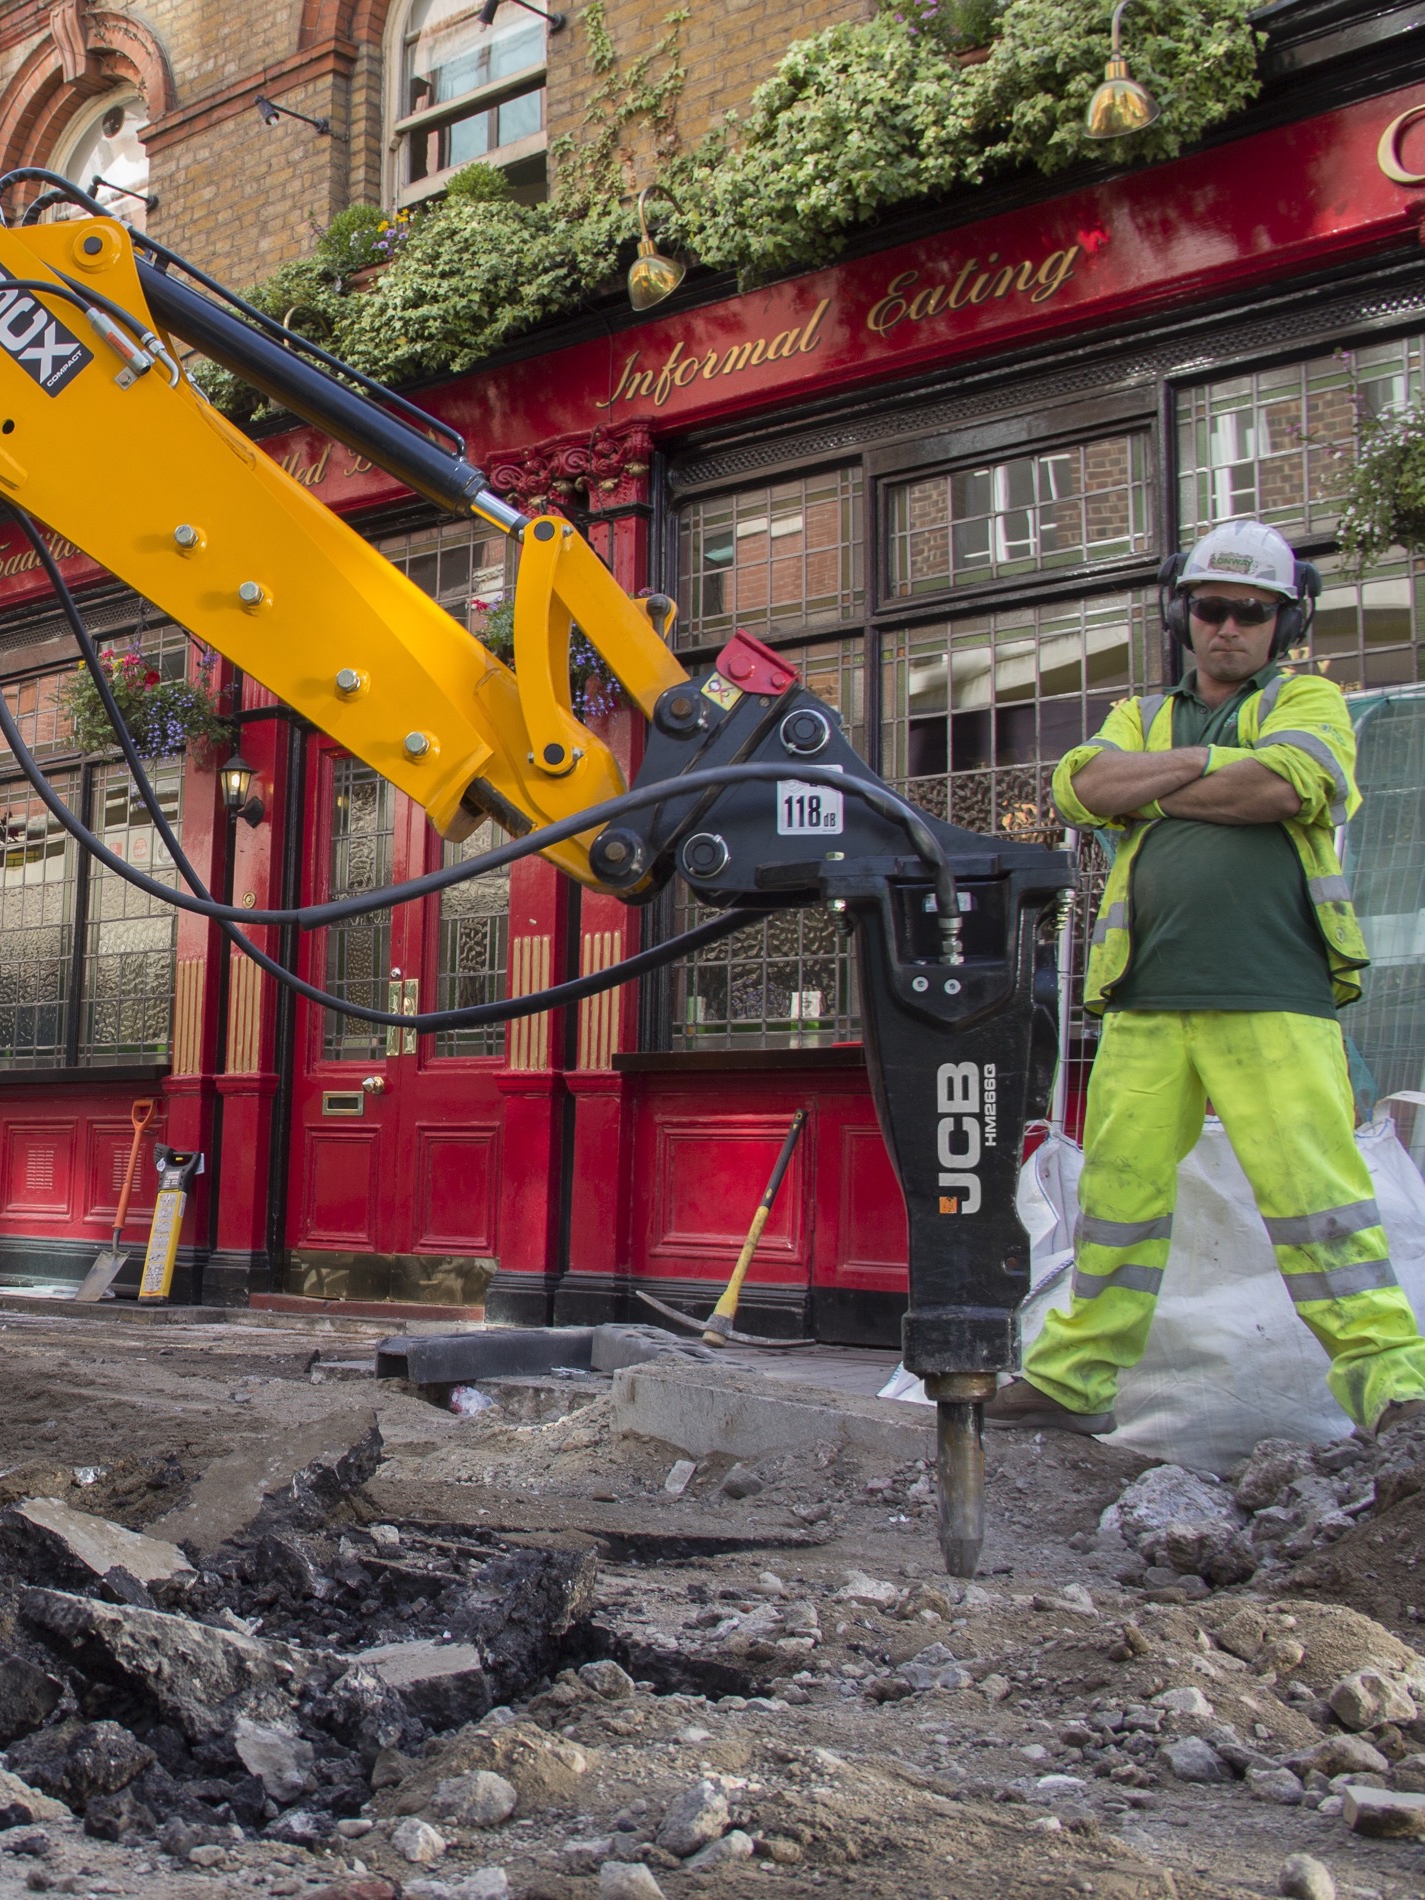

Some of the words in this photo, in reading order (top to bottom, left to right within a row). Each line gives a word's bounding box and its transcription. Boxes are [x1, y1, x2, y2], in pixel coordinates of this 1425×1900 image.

[47, 350, 83, 387] COMPACT
[596, 299, 831, 407] Informal
[865, 245, 1079, 337] Eating
[784, 795, 822, 828] 118
[823, 812, 836, 827] dB
[936, 1061, 982, 1215] JCB
